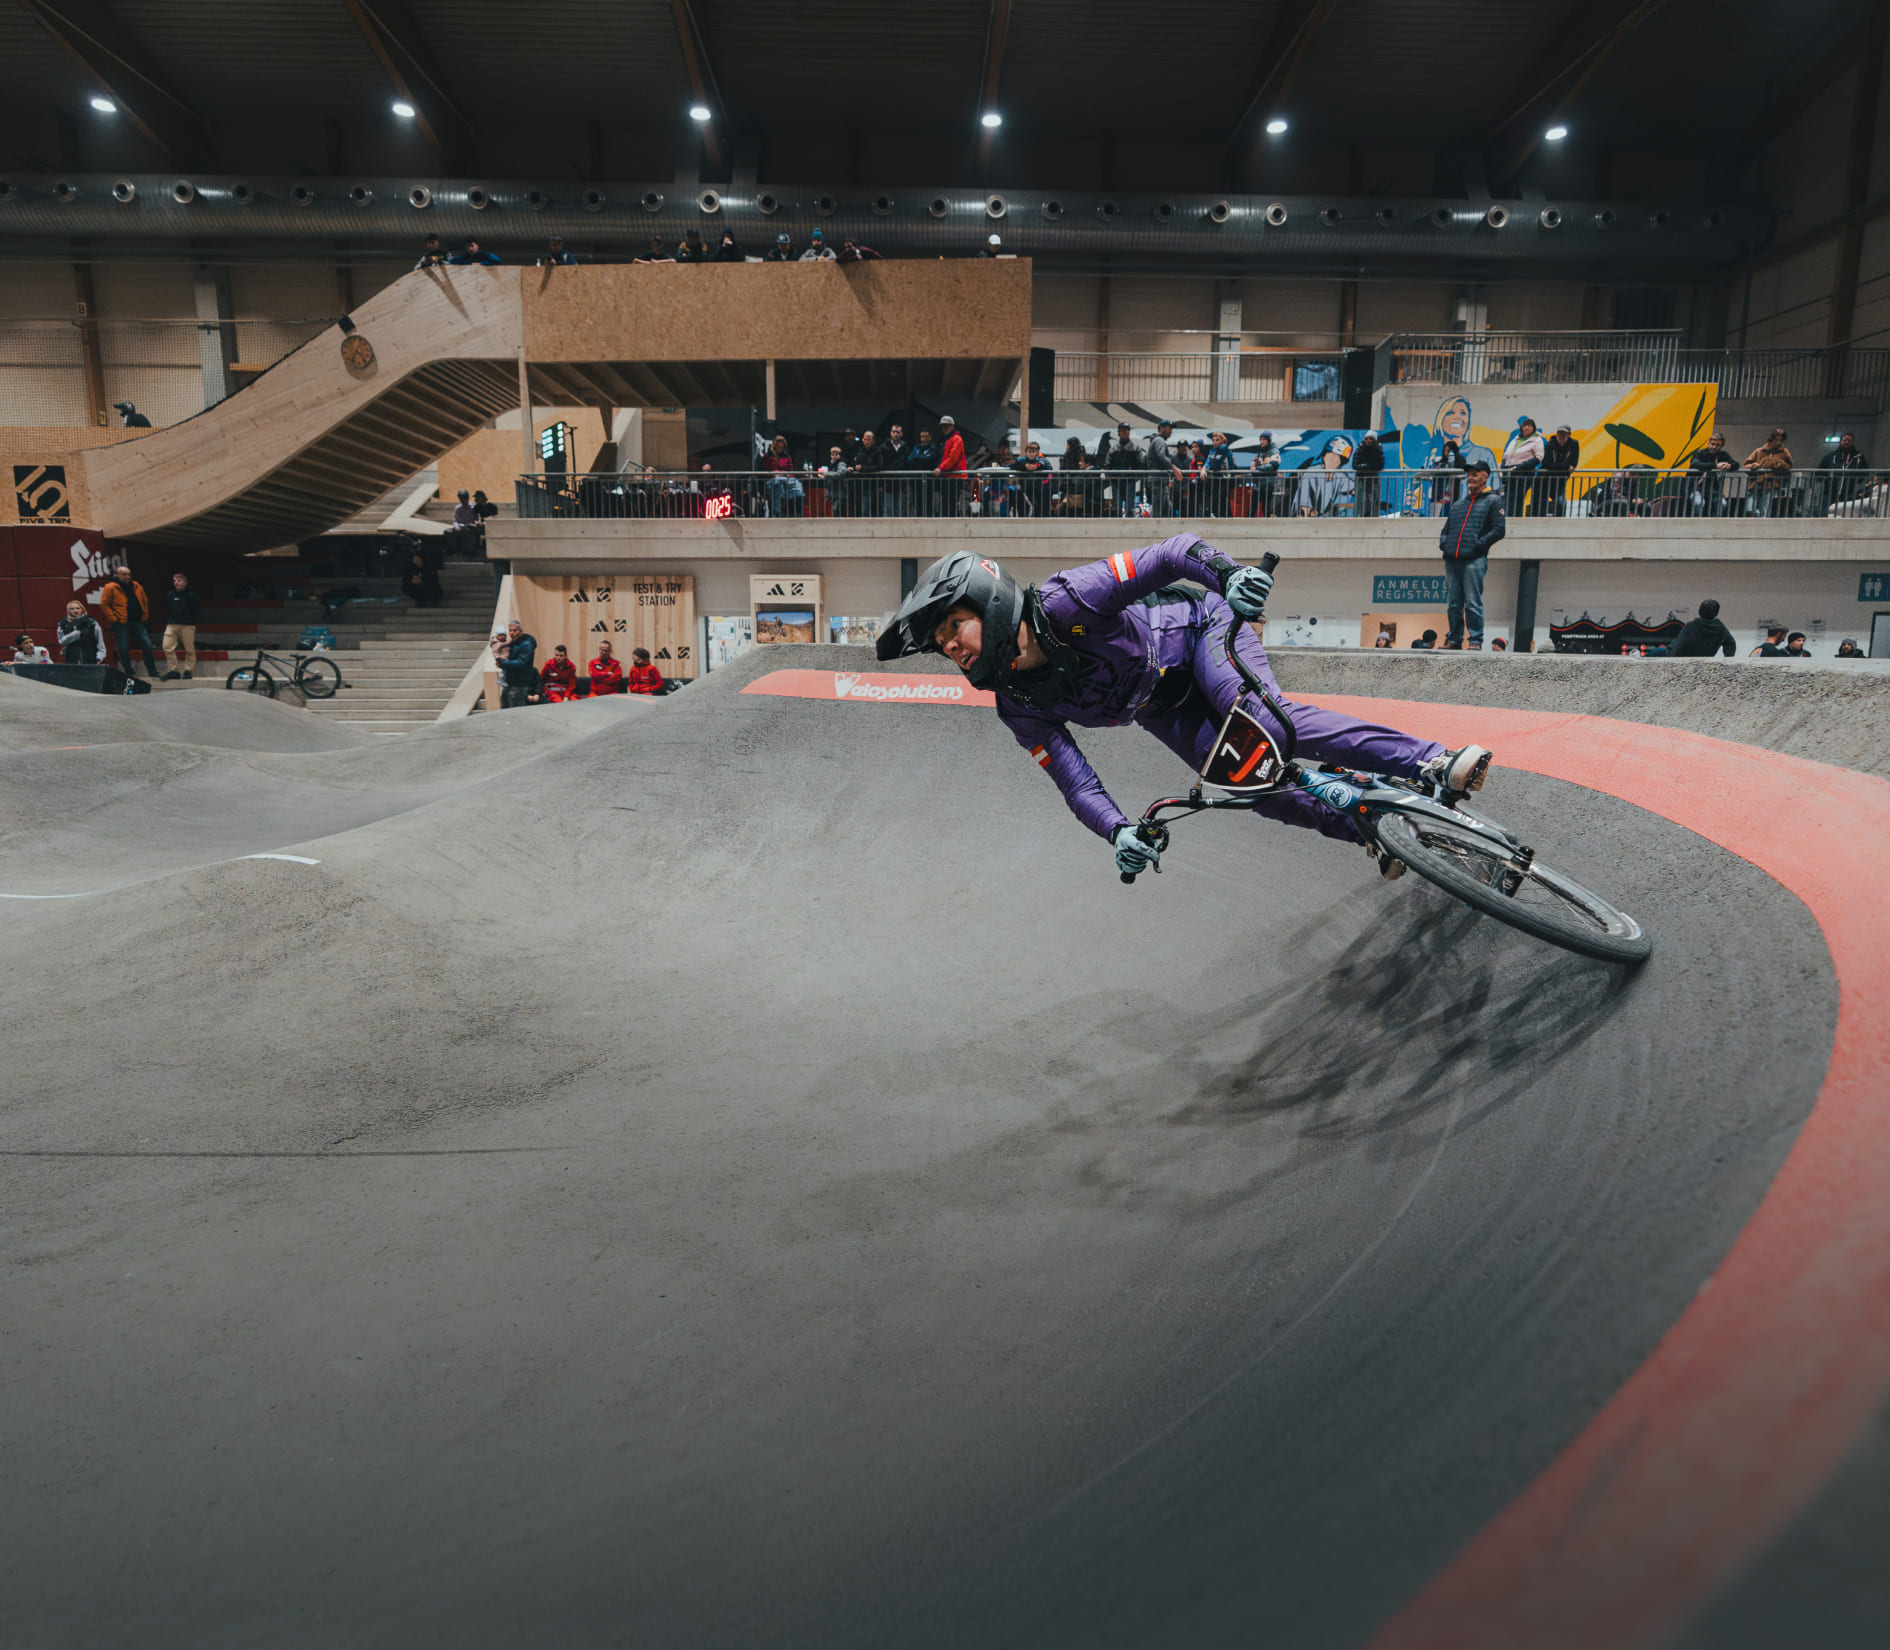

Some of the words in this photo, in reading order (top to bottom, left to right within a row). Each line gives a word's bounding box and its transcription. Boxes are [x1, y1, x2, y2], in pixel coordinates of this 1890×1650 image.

[633, 583, 653, 593] TEST
[655, 583, 663, 593] &
[665, 583, 682, 593] TRY
[638, 595, 676, 606] STATION
[834, 673, 963, 700] Velosolutions
